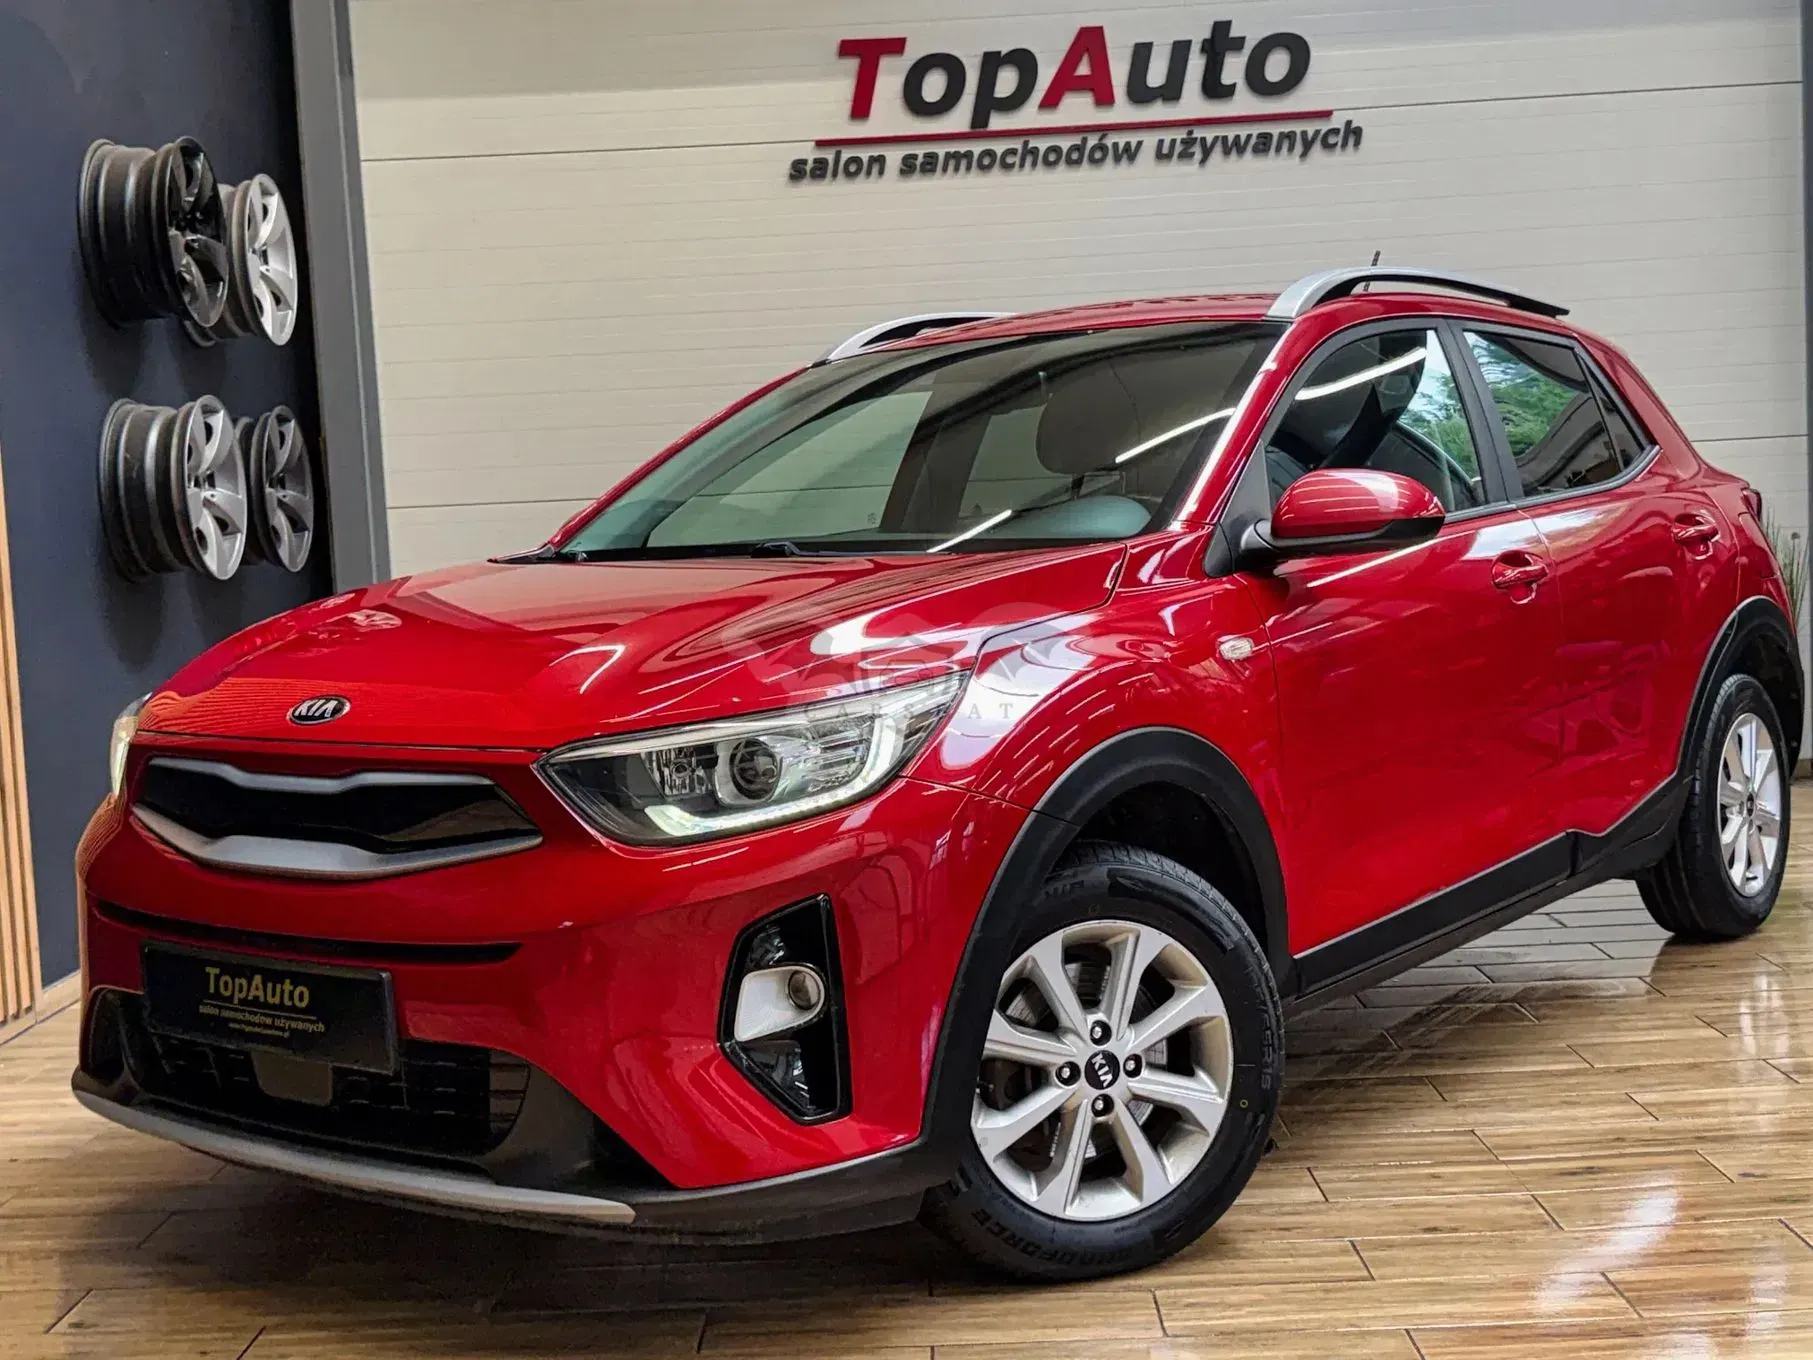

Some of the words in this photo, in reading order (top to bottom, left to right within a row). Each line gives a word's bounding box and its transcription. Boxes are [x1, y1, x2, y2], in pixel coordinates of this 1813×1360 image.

[837, 20, 1312, 130] TopAuto
[788, 149, 886, 182] salon
[899, 132, 1143, 176] samochodów
[1155, 119, 1364, 165] używanych
[293, 699, 339, 718] KIA
[205, 966, 310, 1009] TopAuto
[274, 1016, 325, 1033] używanych
[1090, 1052, 1114, 1088] KIA
